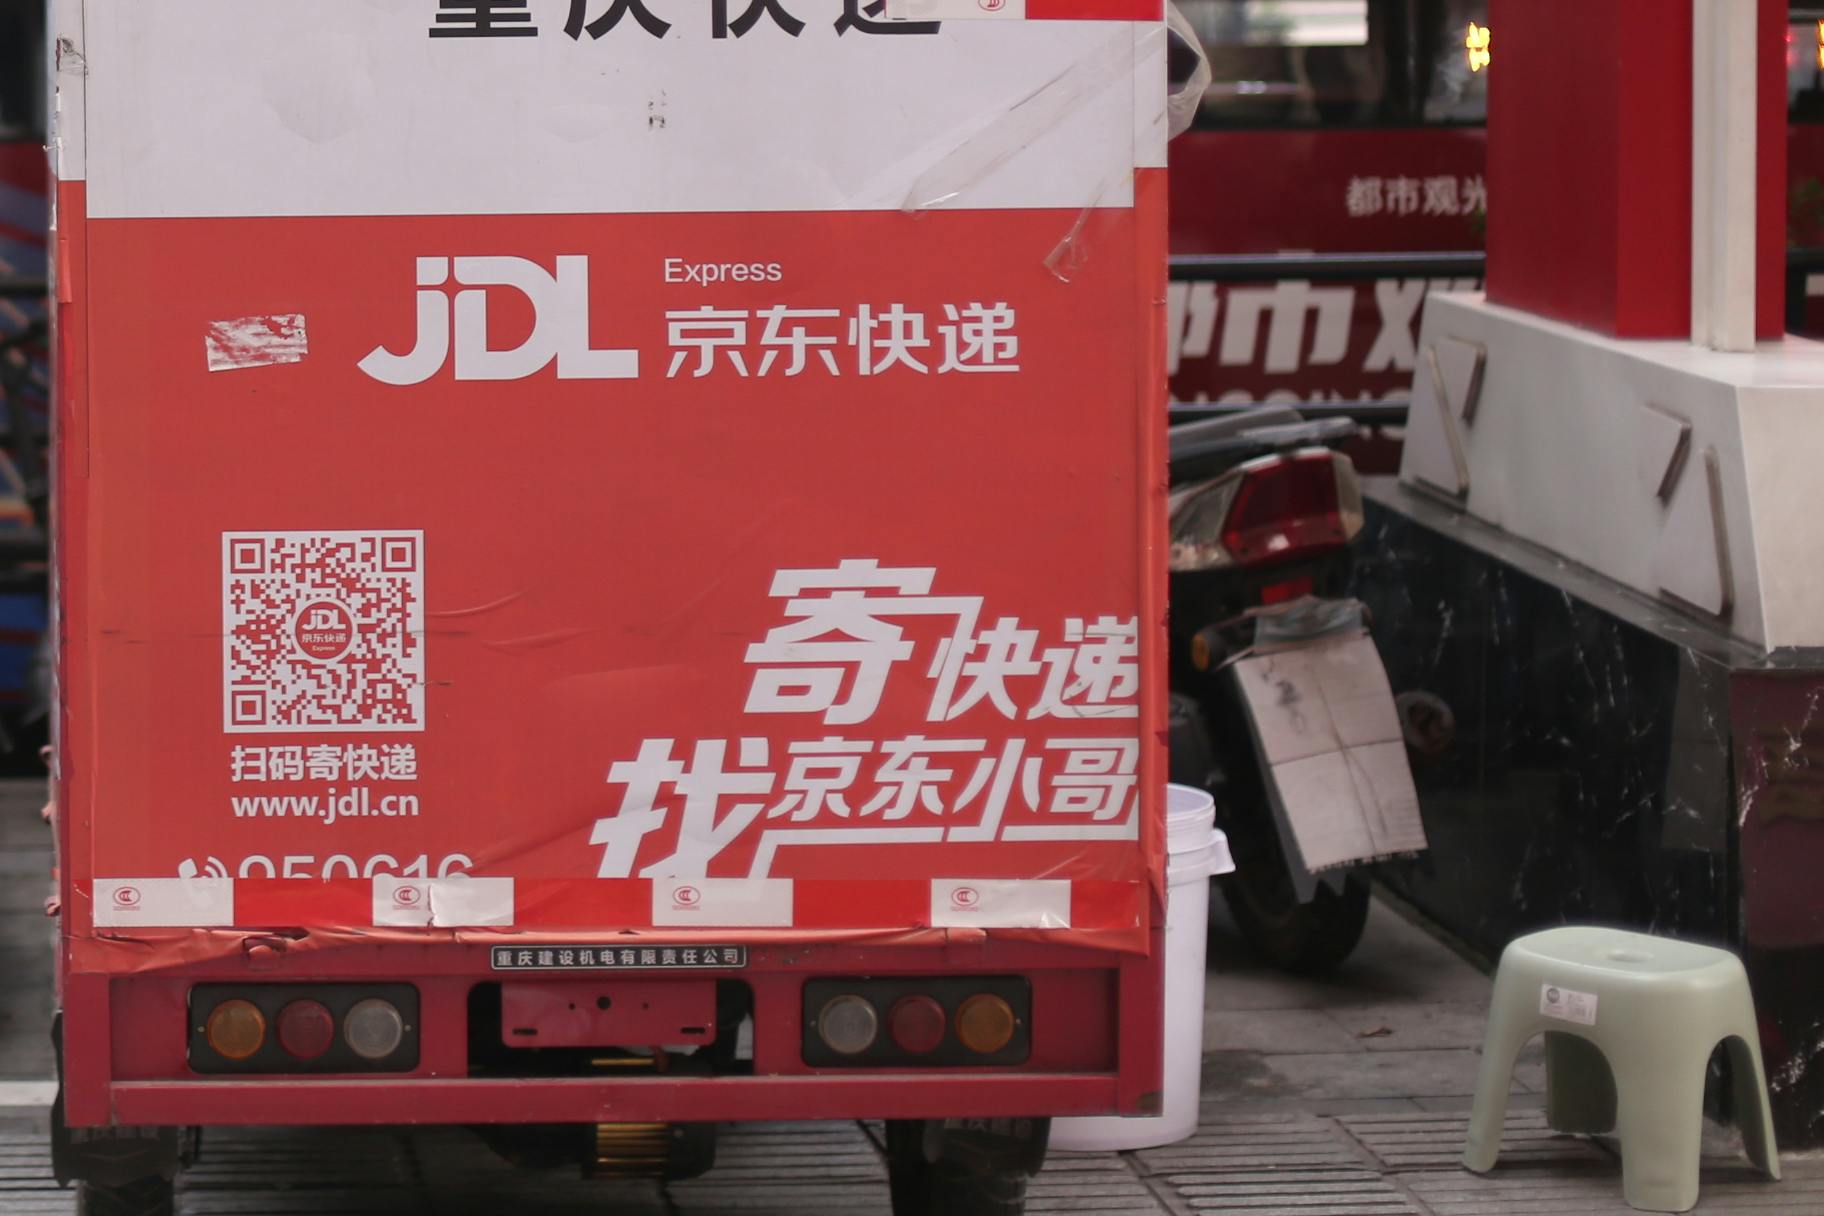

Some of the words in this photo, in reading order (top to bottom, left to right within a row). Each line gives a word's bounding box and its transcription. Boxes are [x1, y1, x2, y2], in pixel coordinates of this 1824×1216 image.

[663, 258, 783, 285] Express
[356, 254, 639, 386] JDL
[664, 302, 1020, 378] 京东快递
[302, 608, 347, 631] JDL
[743, 558, 1139, 725] 寄快递
[230, 743, 419, 782] 扫码寄快递
[230, 787, 420, 825] www.jdl.cn
[587, 735, 1139, 879] 找京东小哥
[496, 947, 740, 967] 重庆建设机电有限责任公司
